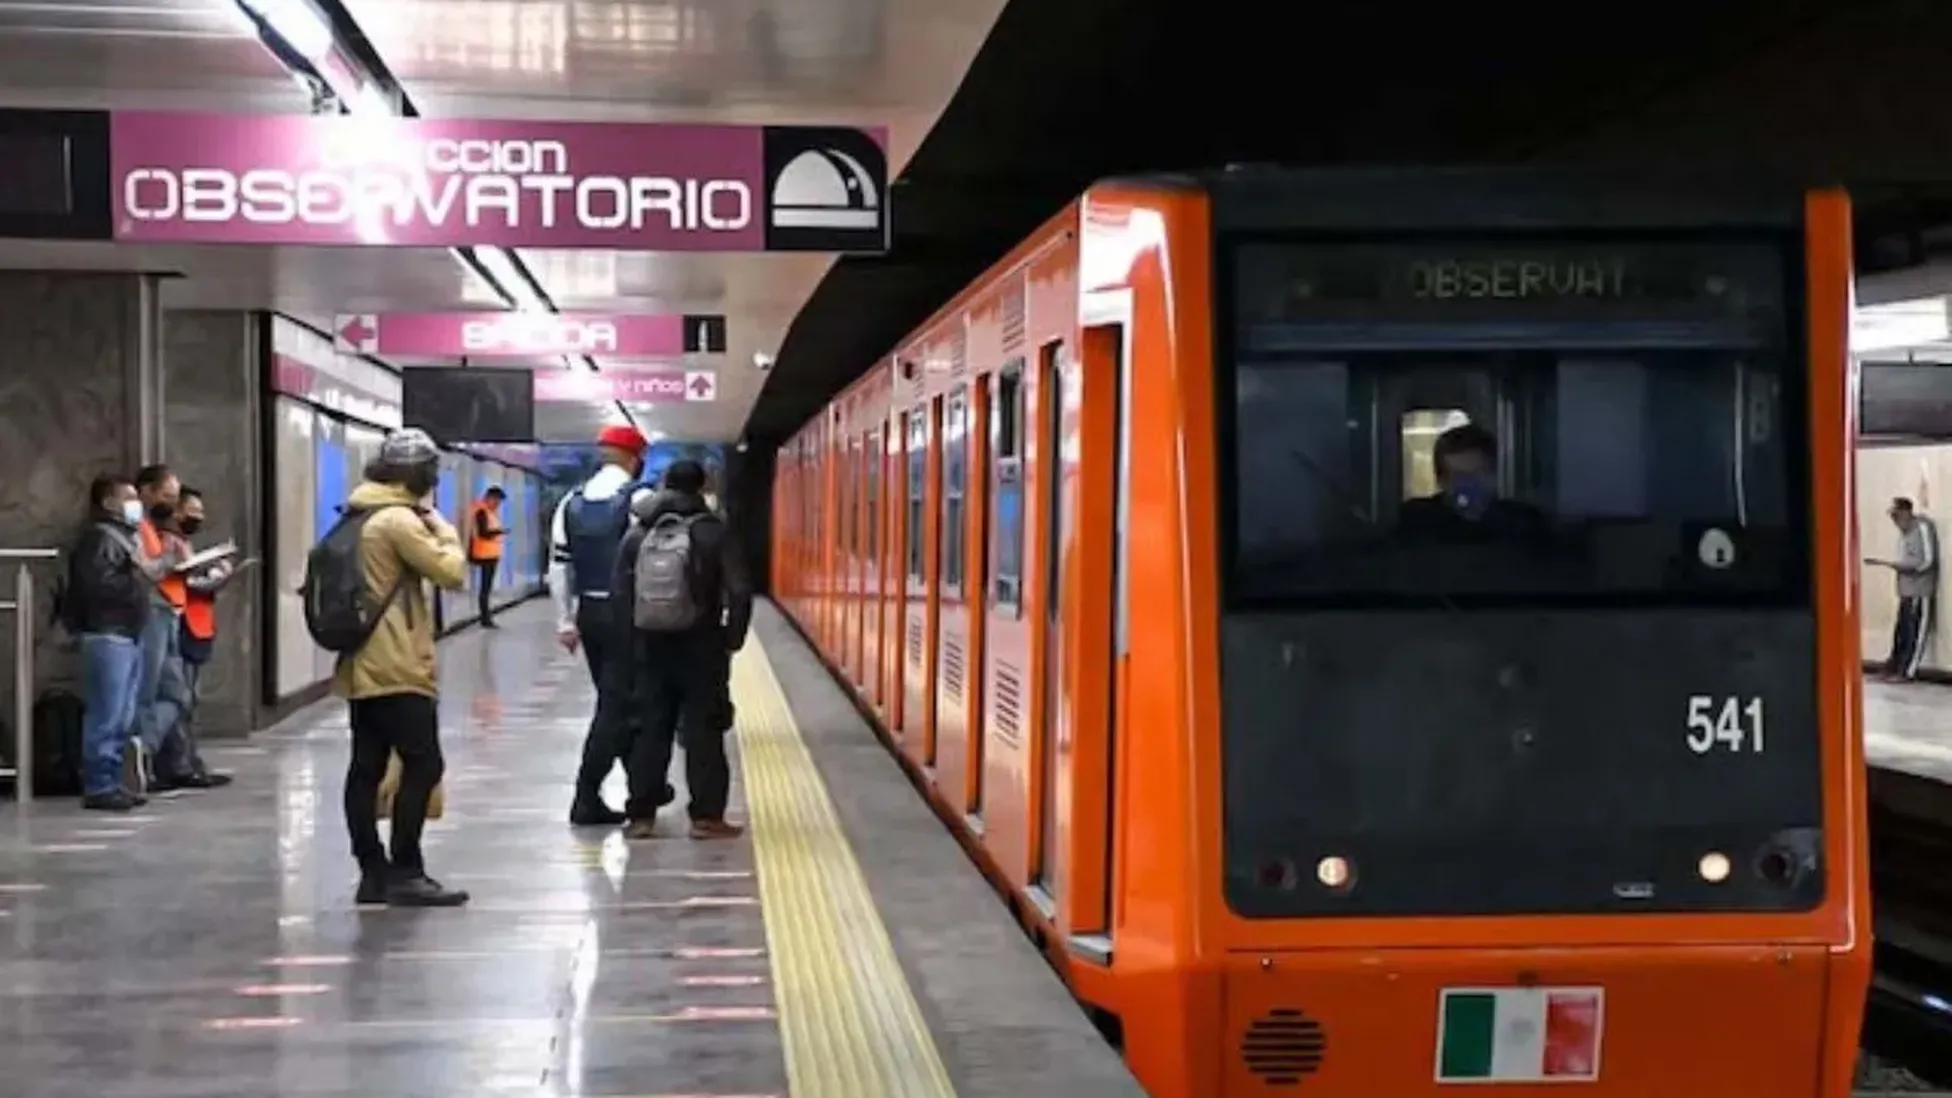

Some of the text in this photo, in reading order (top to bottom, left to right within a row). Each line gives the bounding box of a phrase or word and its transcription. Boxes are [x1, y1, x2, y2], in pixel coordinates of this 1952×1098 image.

[321, 141, 567, 174] CCION
[125, 168, 751, 231] OBSERVATORIO
[462, 321, 617, 351] SDA
[1686, 696, 1765, 753] 541
